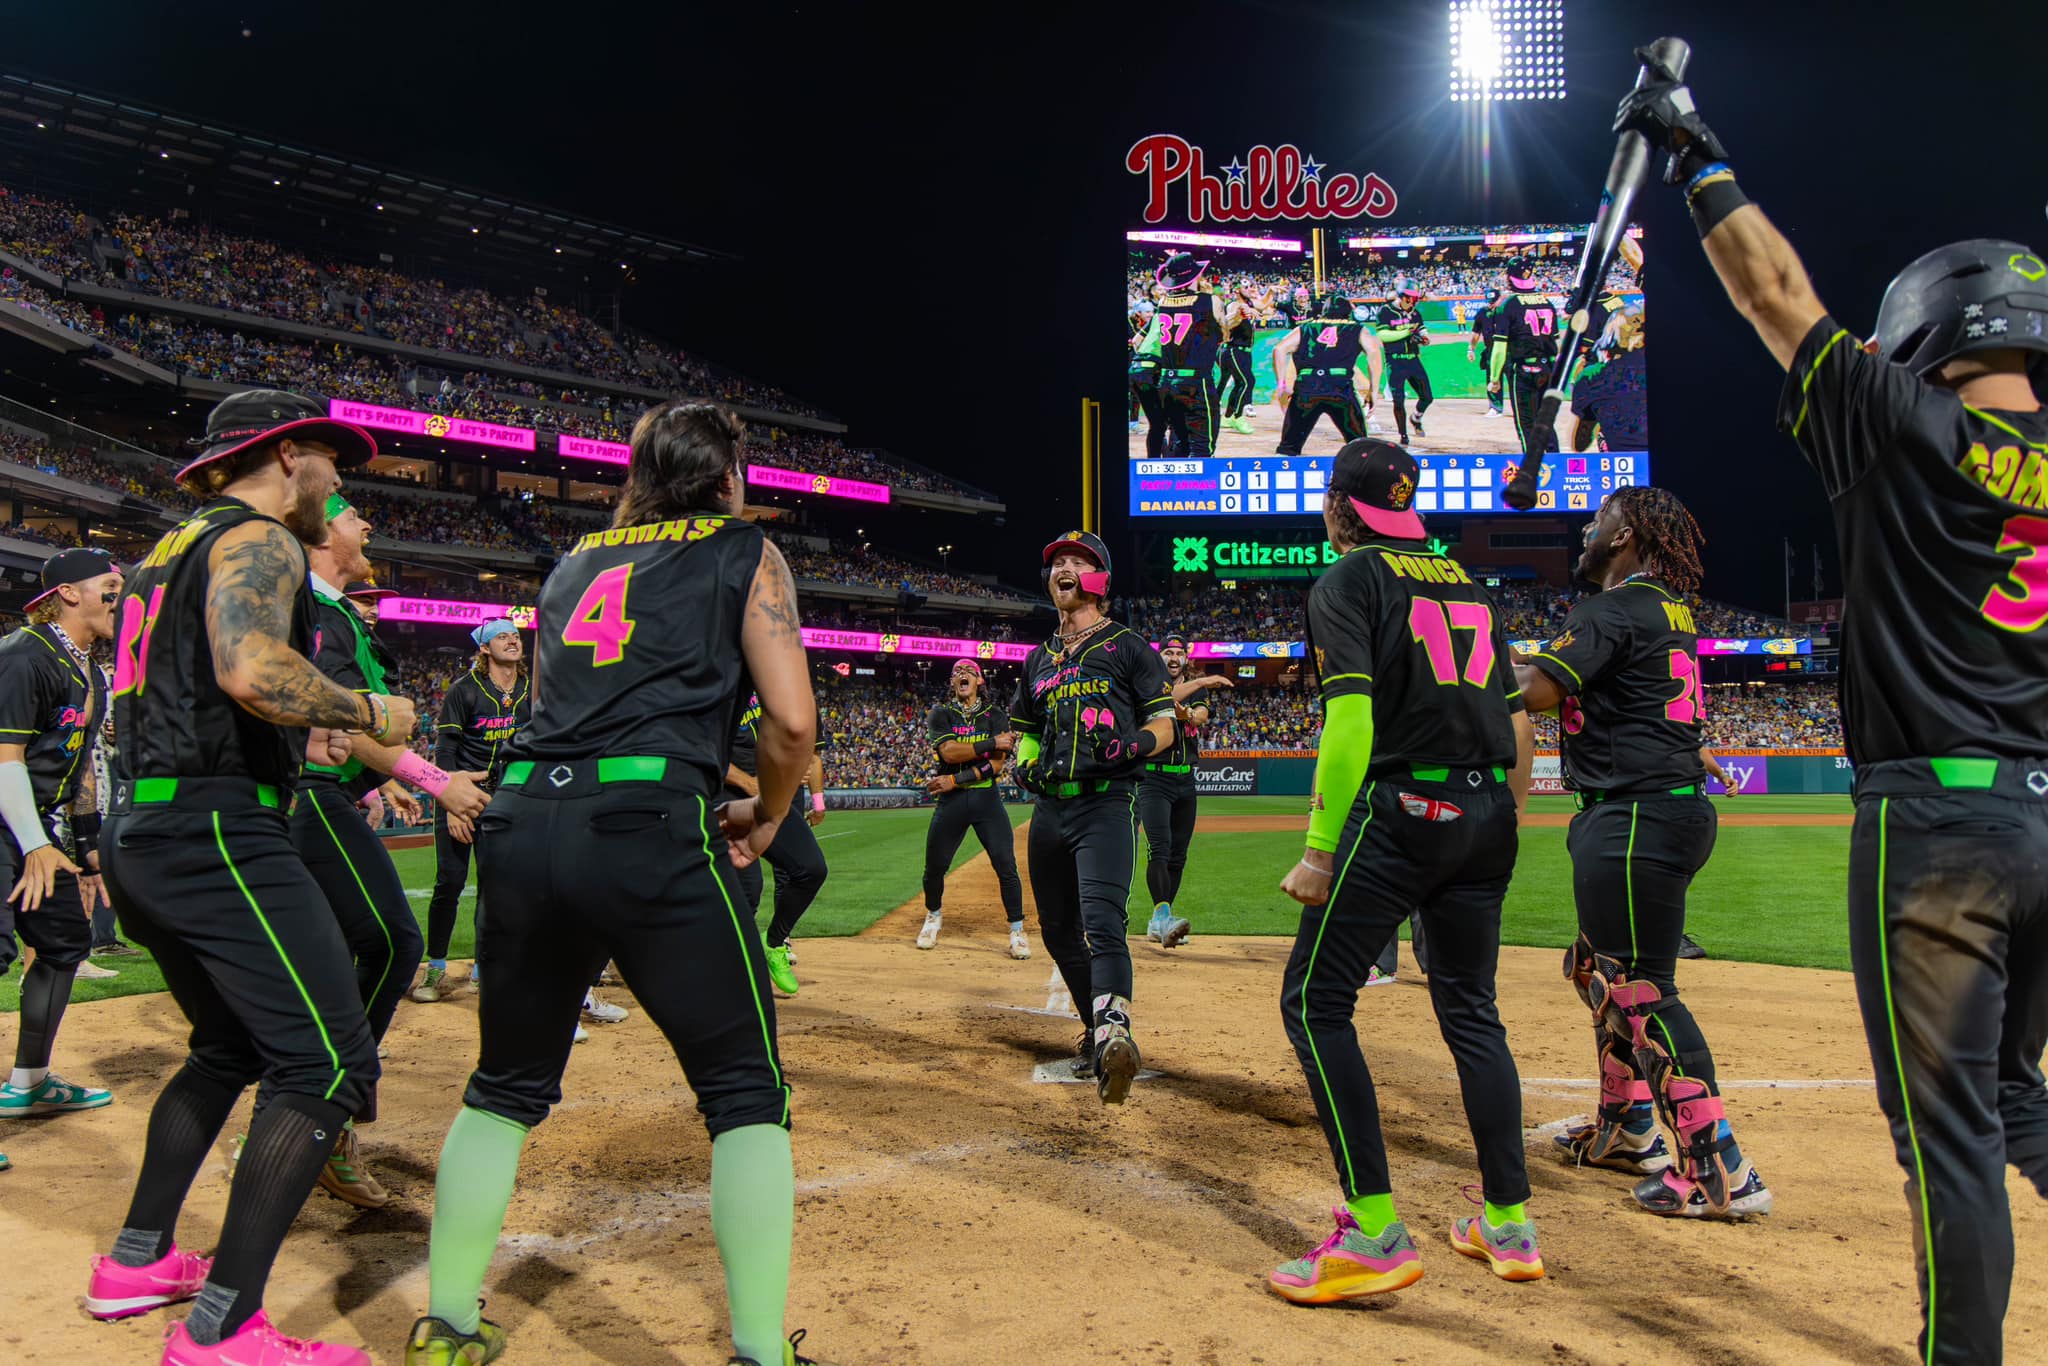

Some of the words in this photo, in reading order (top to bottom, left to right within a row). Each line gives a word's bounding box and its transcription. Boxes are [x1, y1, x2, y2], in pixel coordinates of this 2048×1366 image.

[1126, 134, 1397, 223] Phillies
[1159, 313, 1193, 346] 37
[1524, 309, 1554, 336] 17
[1316, 326, 1338, 348] 4
[342, 406, 373, 421] LET'S
[459, 424, 487, 438] LET'S
[569, 442, 594, 455] LET'S
[1226, 461, 1233, 470] 1
[1253, 461, 1262, 470] 2
[1281, 461, 1290, 470] 3
[1309, 460, 1318, 469] 4
[1421, 458, 1429, 468] 8
[1449, 458, 1457, 467] 9
[1476, 457, 1485, 467] S
[1573, 461, 1581, 472] 2
[1601, 458, 1610, 471] B
[1225, 474, 1236, 487] 0
[1255, 474, 1261, 487] 1
[1601, 476, 1611, 489] S
[1140, 501, 1217, 511] BANANAS
[1225, 496, 1236, 509] 0
[1255, 496, 1261, 509] 1
[1572, 494, 1582, 507] 4
[1214, 542, 1317, 565] Citizens
[1380, 552, 1473, 584] PONCE
[400, 601, 434, 616] LET'S
[561, 562, 636, 667] 4
[811, 632, 835, 644] LET'S
[1408, 595, 1495, 689] 17
[1195, 784, 1252, 792] HABILITATION
[1528, 780, 1563, 791] AGE
